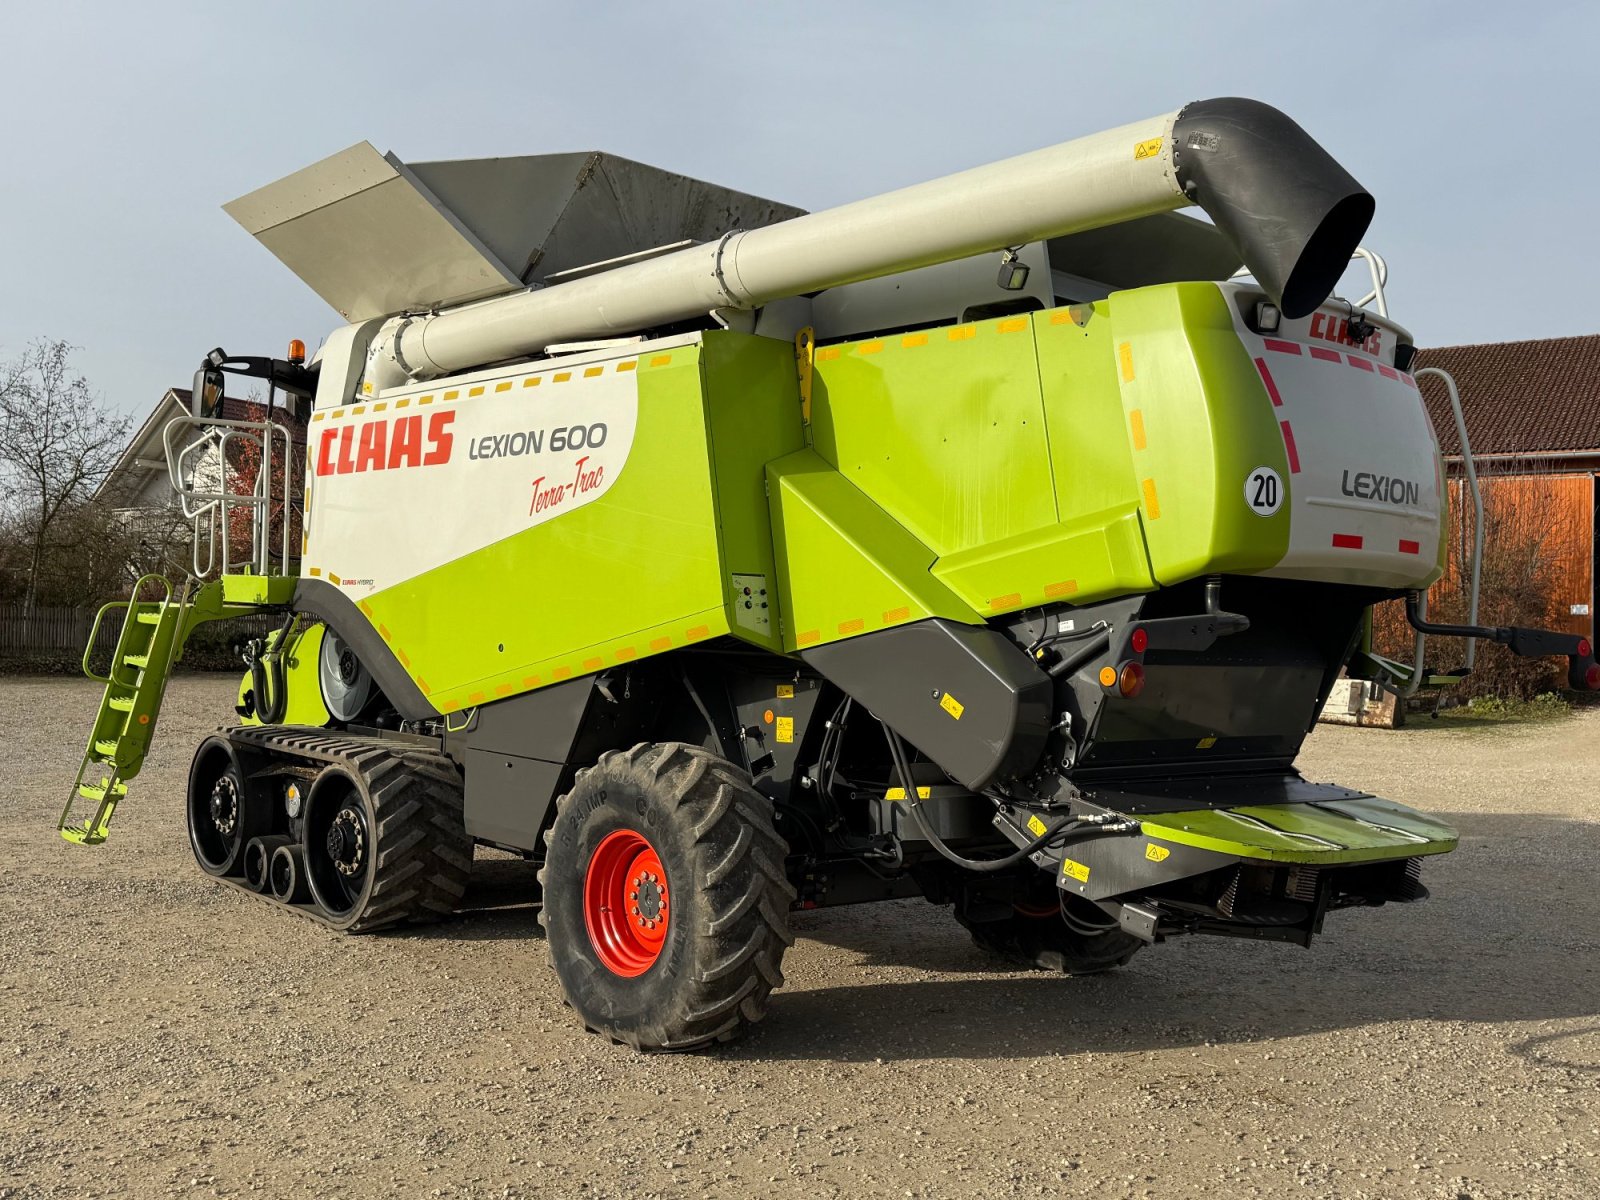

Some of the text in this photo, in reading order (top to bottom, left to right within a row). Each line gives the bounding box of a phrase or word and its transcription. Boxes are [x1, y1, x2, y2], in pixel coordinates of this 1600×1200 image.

[317, 410, 456, 477] CLAAS
[469, 422, 608, 460] LEXION 600
[529, 455, 604, 517] Terra-Trac
[1253, 474, 1277, 507] 20
[1341, 469, 1419, 505] LEXION
